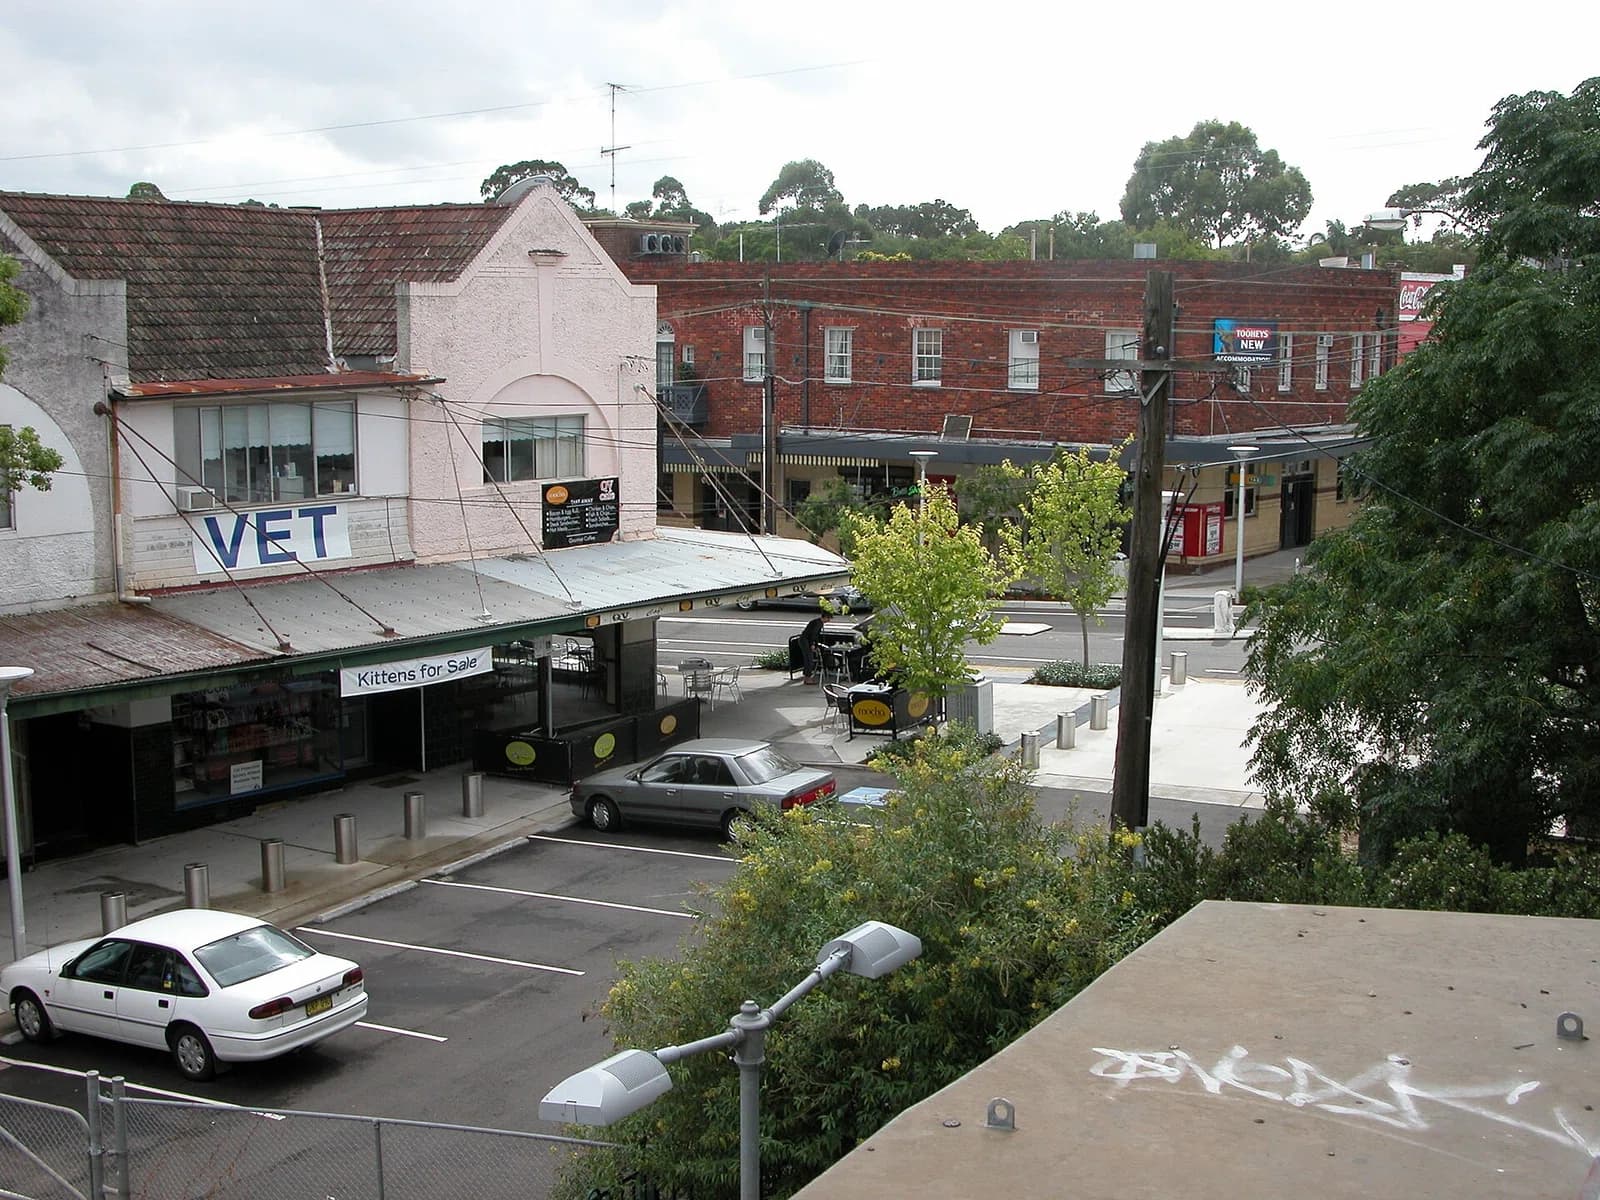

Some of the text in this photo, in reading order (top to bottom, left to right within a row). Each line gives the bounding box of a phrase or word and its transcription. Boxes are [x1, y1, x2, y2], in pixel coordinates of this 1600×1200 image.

[1236, 329, 1269, 339] TOOHEYS
[1240, 340, 1264, 350] NEW
[204, 506, 337, 569] VET
[612, 611, 629, 622] QV
[357, 656, 477, 687] Kittens for Sale
